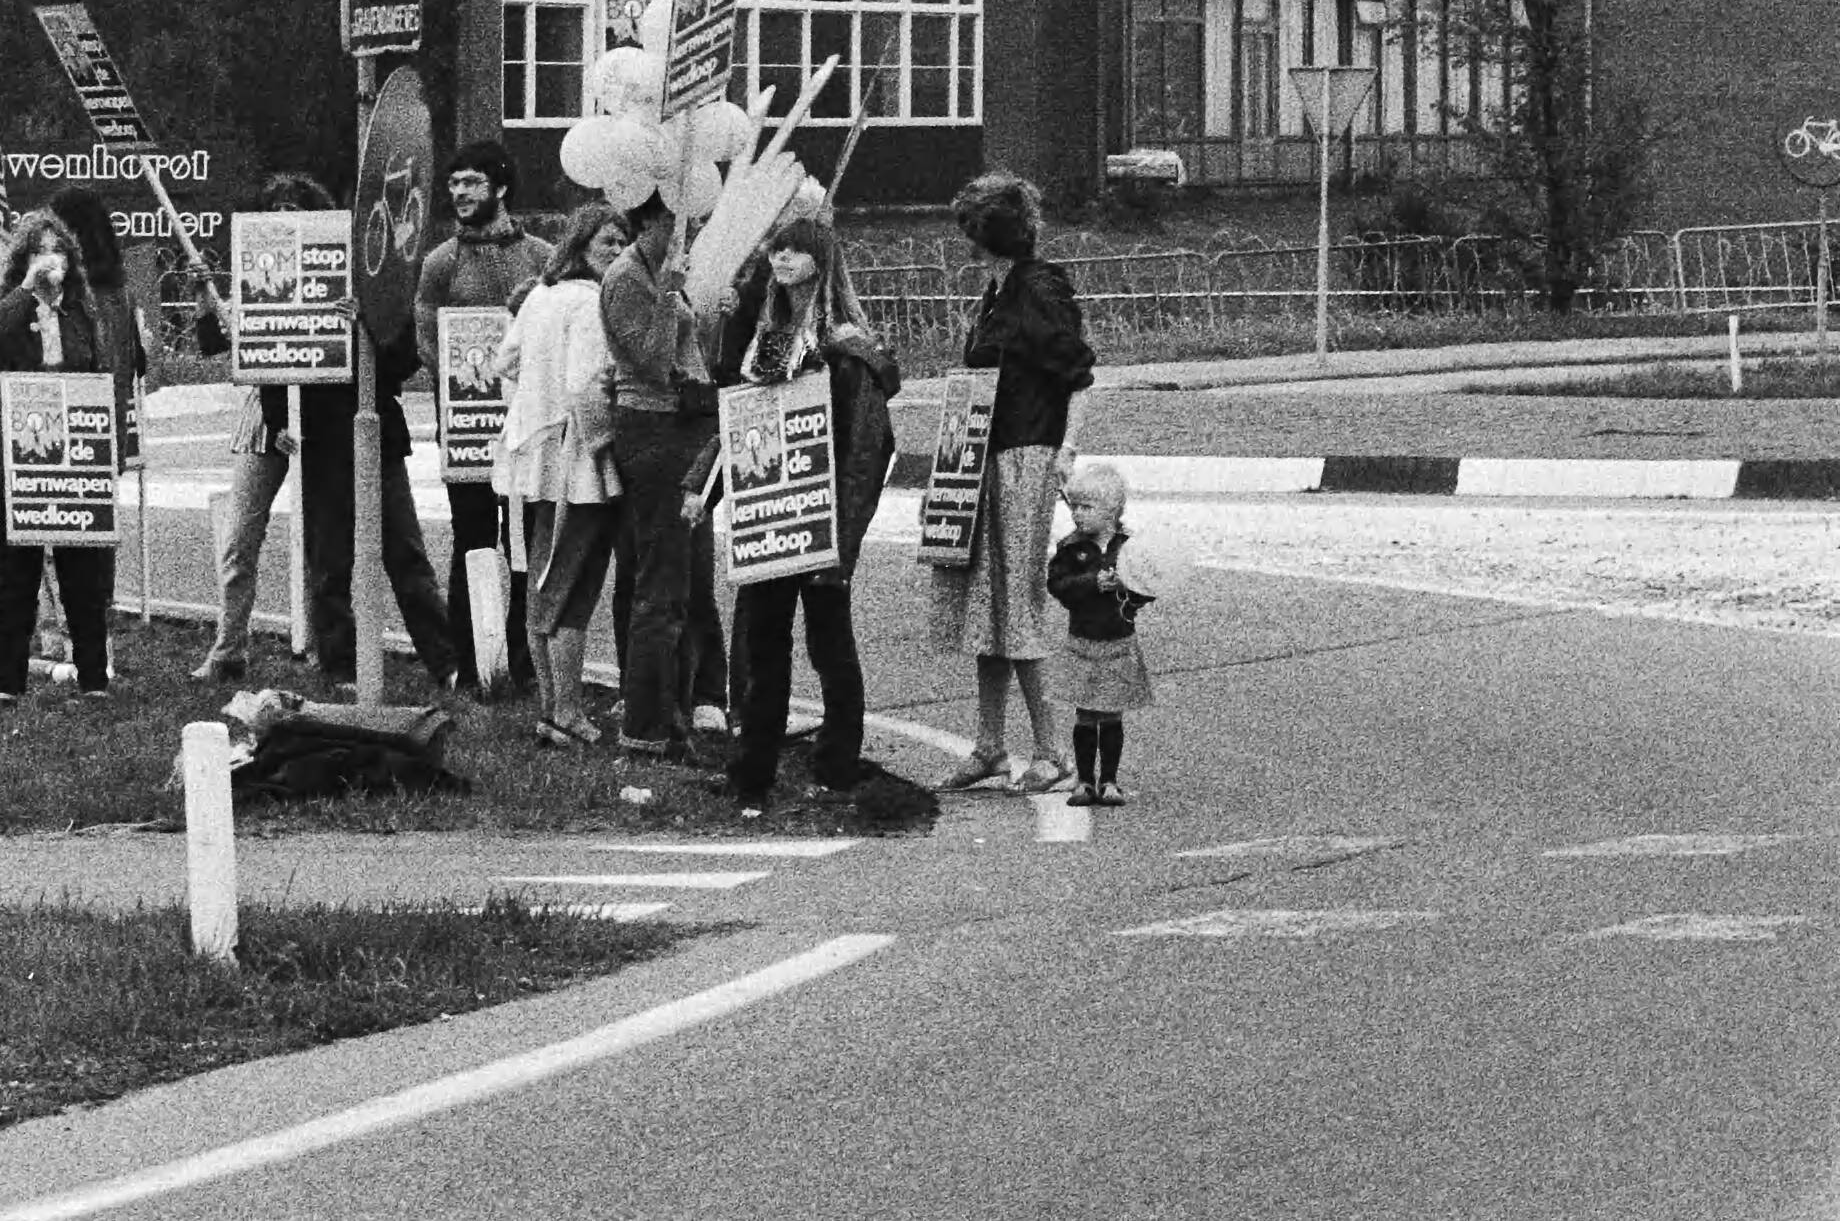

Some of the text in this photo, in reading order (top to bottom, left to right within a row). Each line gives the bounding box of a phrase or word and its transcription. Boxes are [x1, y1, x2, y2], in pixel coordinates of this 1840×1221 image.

[110, 207, 223, 237] enter
[302, 247, 345, 269] stop
[303, 277, 328, 298] de
[240, 311, 345, 334] kernwapen
[239, 343, 325, 368] wedloop
[68, 409, 109, 433] stop
[448, 408, 505, 428] kernw
[786, 412, 826, 437] stop
[70, 438, 95, 460] de
[789, 449, 813, 474] de
[12, 471, 113, 498] kernwapen
[13, 504, 95, 531] wedloop
[731, 487, 831, 524] kernwapen
[734, 530, 813, 561] wedloop
